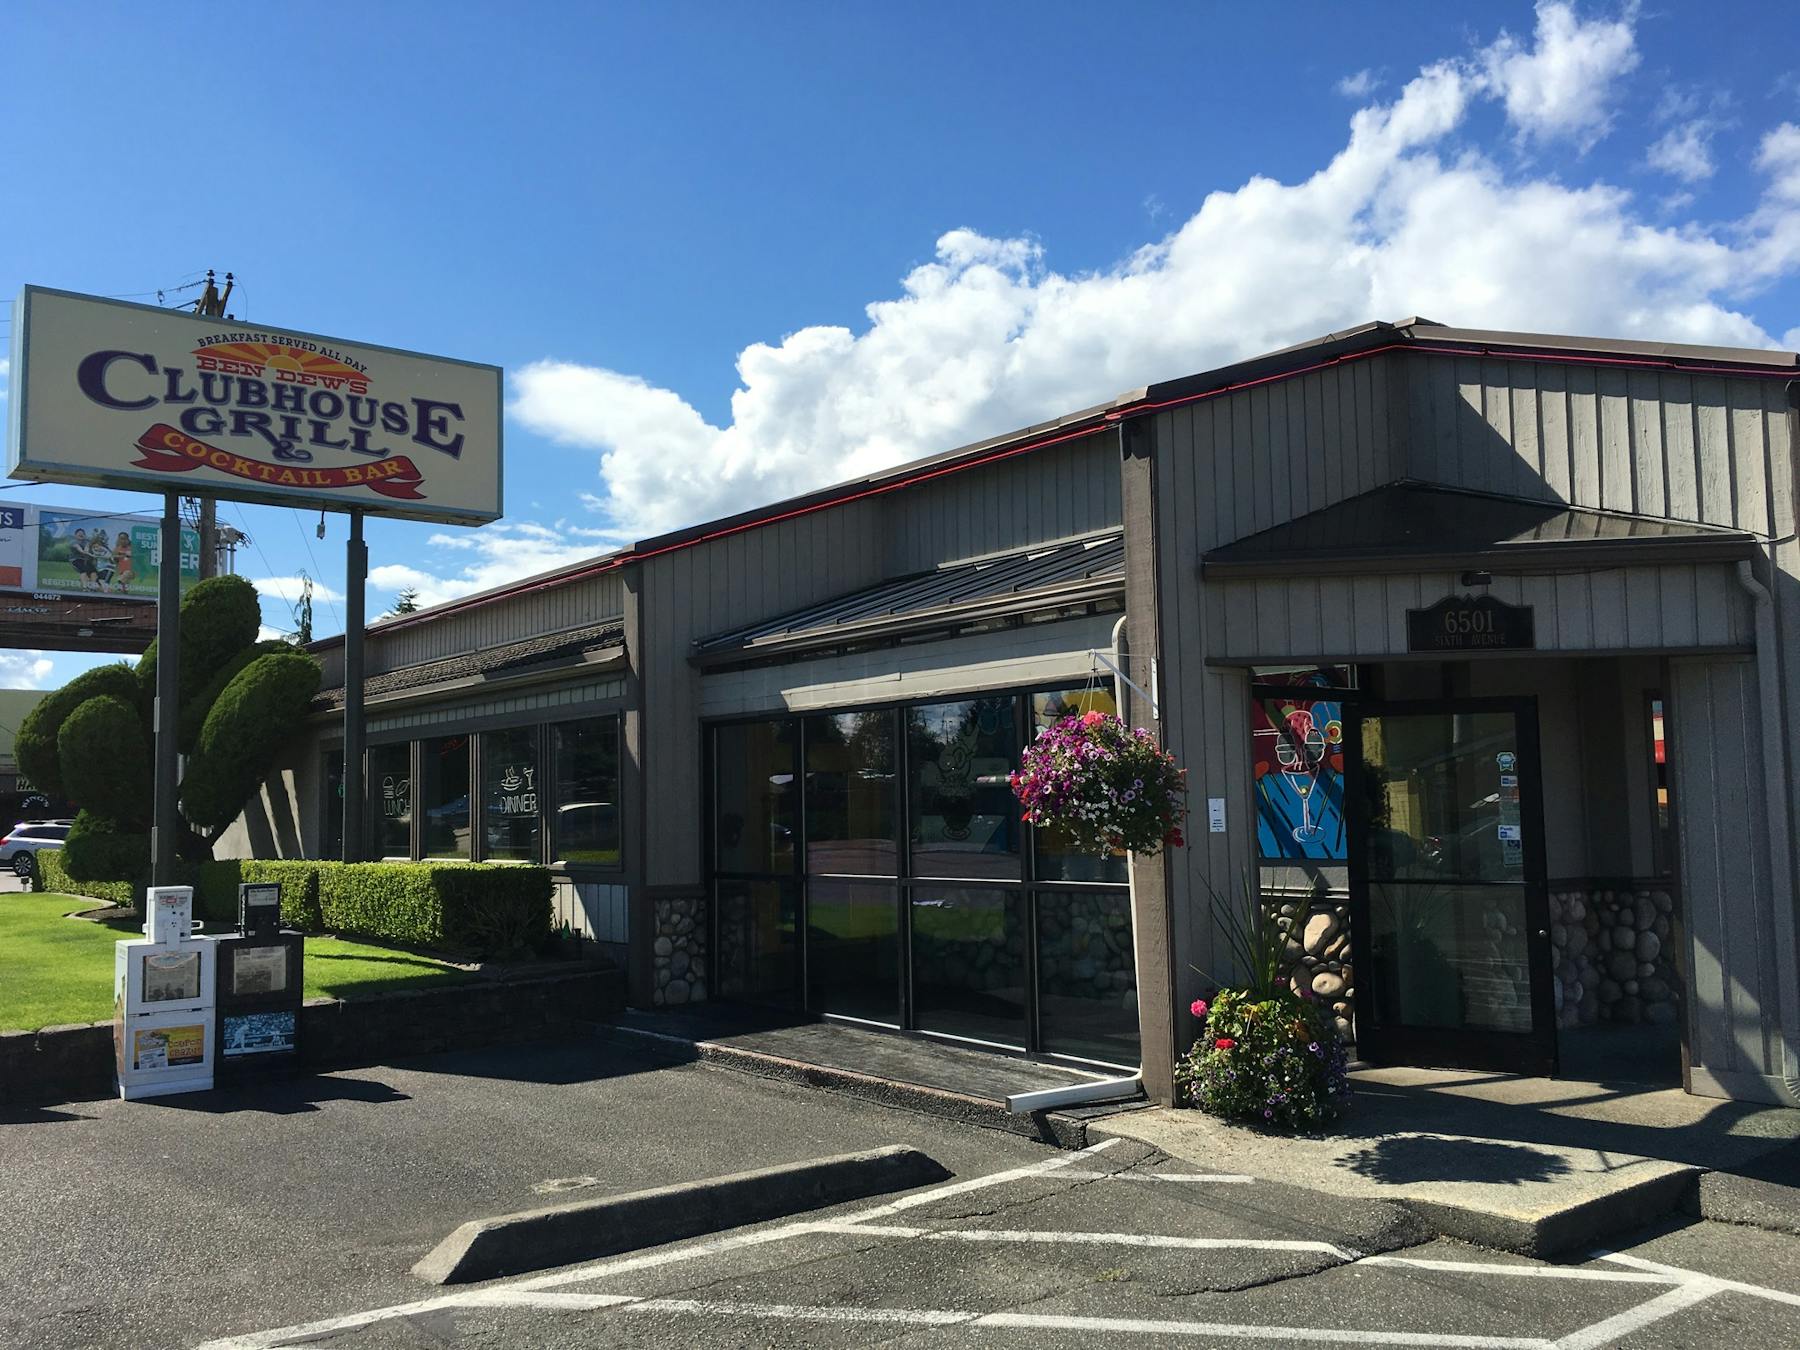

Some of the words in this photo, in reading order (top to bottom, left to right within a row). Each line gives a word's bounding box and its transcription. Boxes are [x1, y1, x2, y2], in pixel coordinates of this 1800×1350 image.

[197, 333, 267, 347] BREAKFAST
[271, 335, 317, 353] SERVED
[319, 346, 341, 361] ALL
[344, 356, 368, 374] DAY
[196, 356, 266, 378] BEN
[276, 368, 368, 395] DEW'S
[77, 350, 465, 460] CLUBHOUSE
[180, 406, 391, 459] GRILL
[271, 439, 314, 463] &
[162, 431, 332, 486] COCKTAIL
[342, 459, 404, 484] BAR
[1435, 634, 1463, 647] SIXTH
[1472, 633, 1505, 646] AVENUE
[1445, 610, 1495, 633] 6501
[500, 793, 538, 815] DINNER
